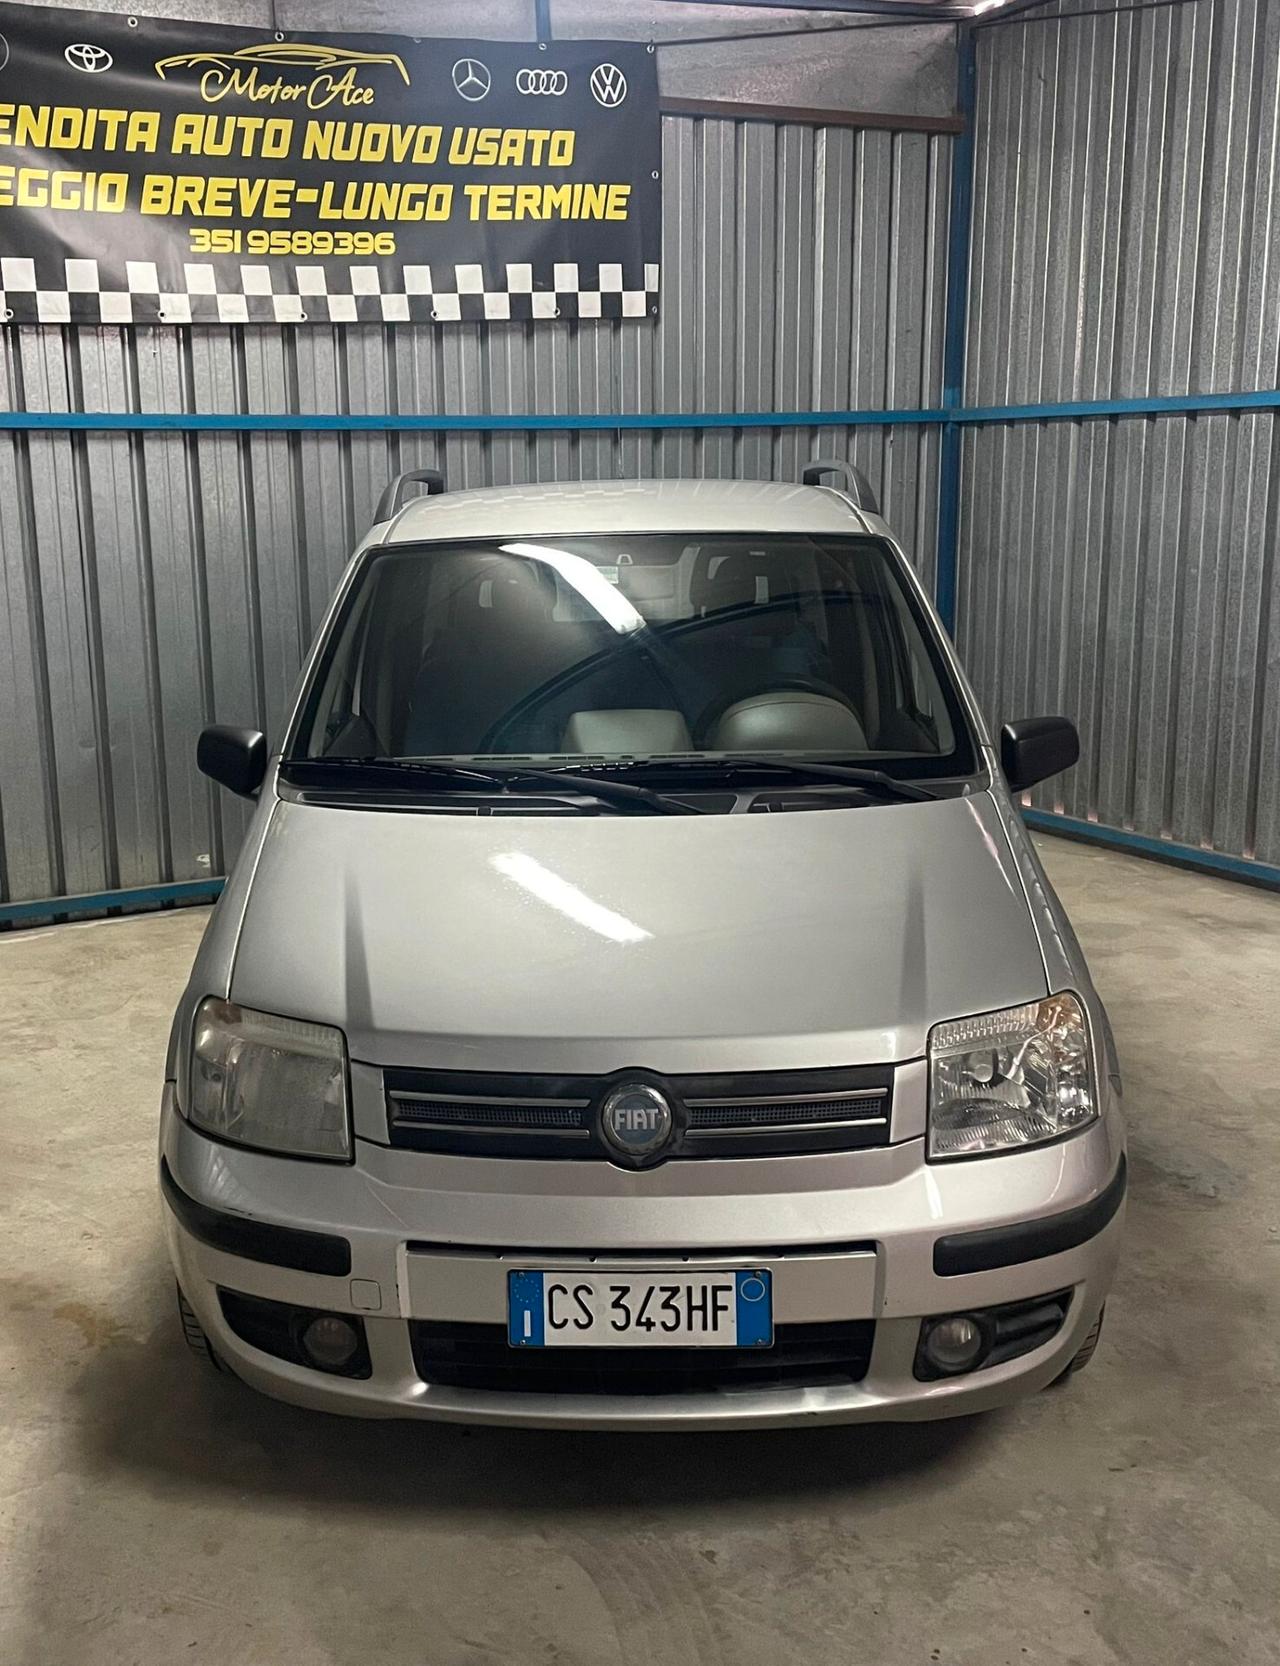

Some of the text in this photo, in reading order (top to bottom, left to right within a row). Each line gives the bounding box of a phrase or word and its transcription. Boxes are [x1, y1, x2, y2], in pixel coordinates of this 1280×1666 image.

[201, 67, 374, 110] Motor Ace
[171, 113, 294, 159] AUTO
[302, 120, 442, 164] NUOVO
[448, 127, 576, 167] USATO
[463, 184, 632, 221] TERMINE
[189, 228, 397, 256] 351 9589396
[614, 1108, 659, 1131] FIAT
[547, 1283, 733, 1332] CS 343HF
